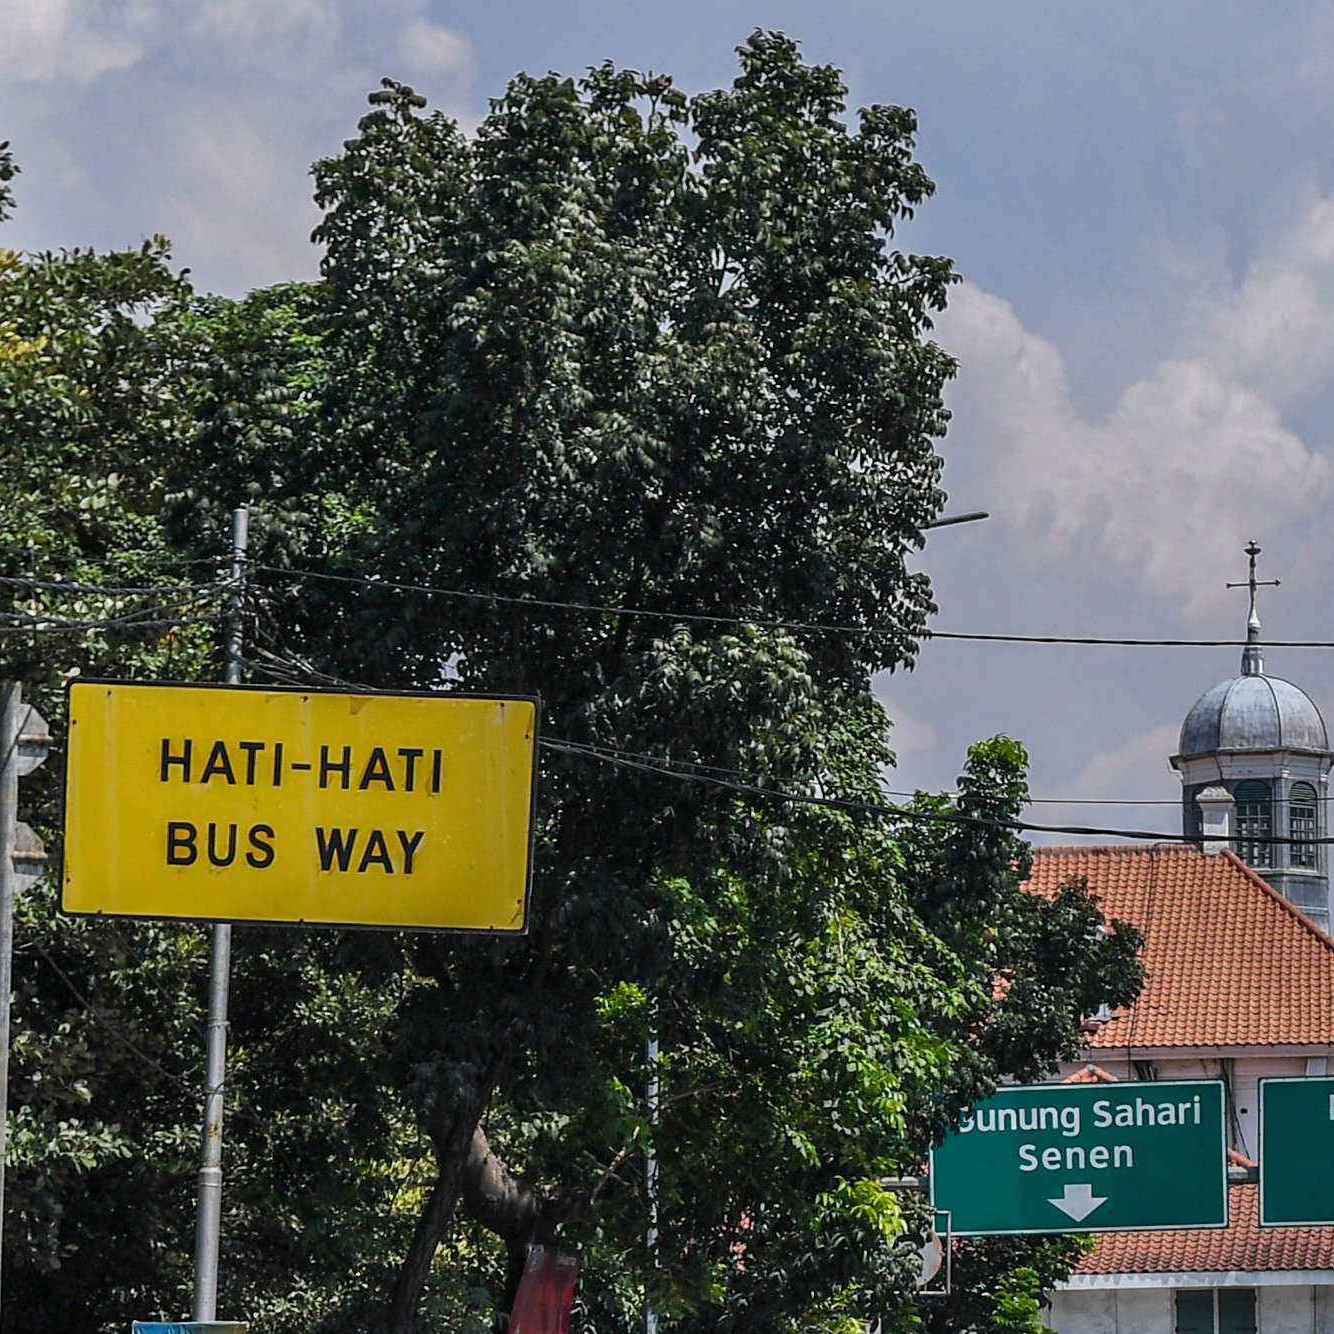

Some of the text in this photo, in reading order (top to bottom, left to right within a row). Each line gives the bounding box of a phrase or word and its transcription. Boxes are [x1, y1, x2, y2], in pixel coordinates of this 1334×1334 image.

[160, 738, 443, 794] HATI-HATI
[166, 822, 425, 874] BUS WAY
[1093, 1095, 1201, 1128] Sahari
[1019, 1144, 1134, 1172] Senen
